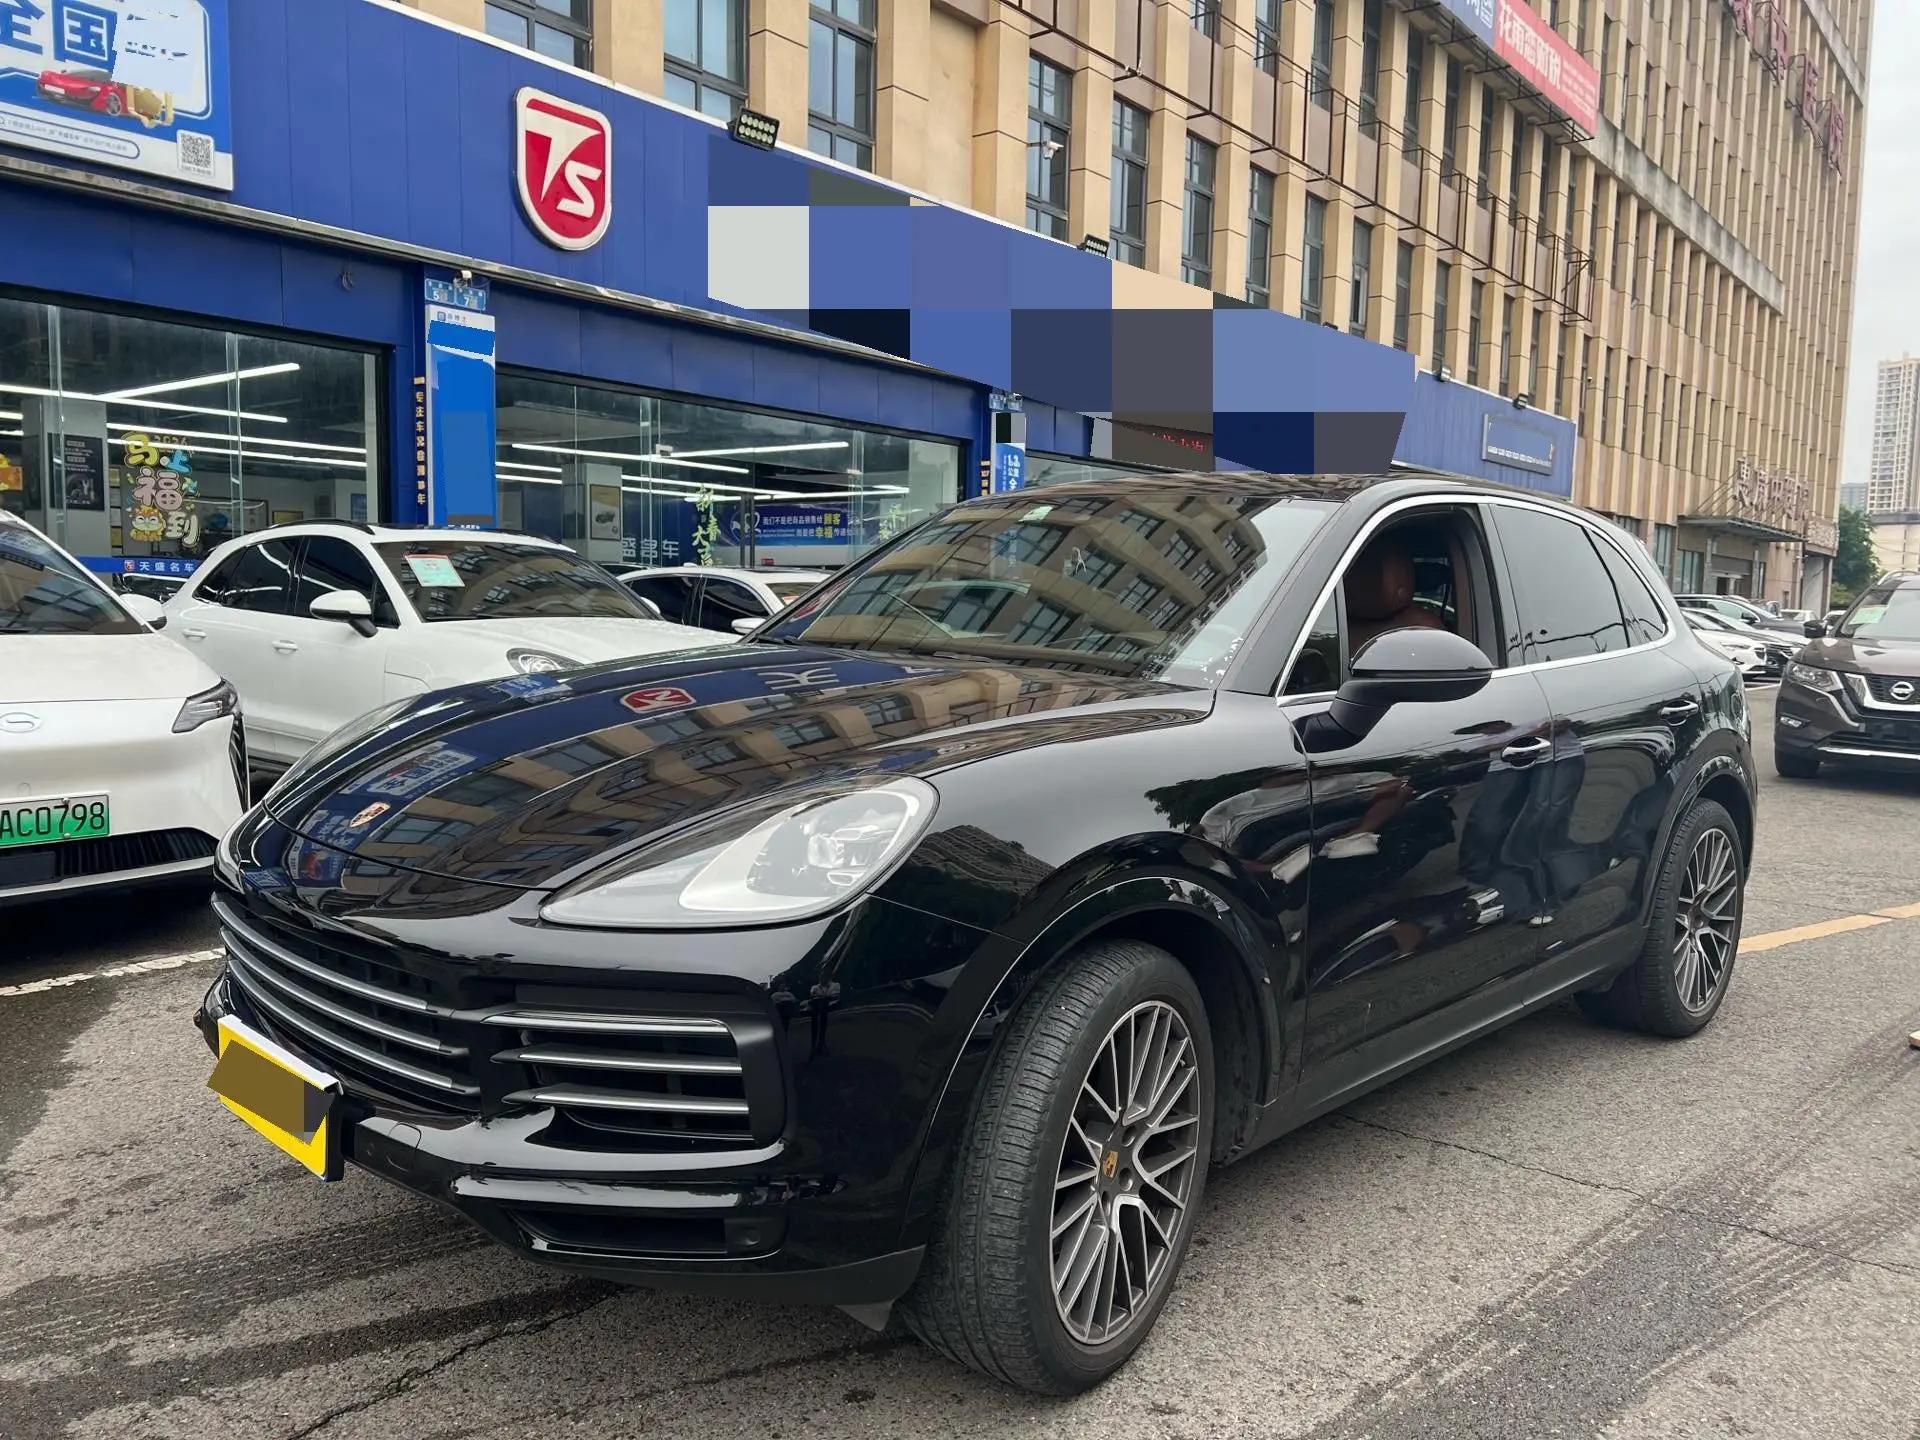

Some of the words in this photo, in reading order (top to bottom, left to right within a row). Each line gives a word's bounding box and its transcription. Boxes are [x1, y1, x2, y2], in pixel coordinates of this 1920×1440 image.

[139, 561, 194, 572] 天盛名车
[0, 802, 105, 839] AC0798
